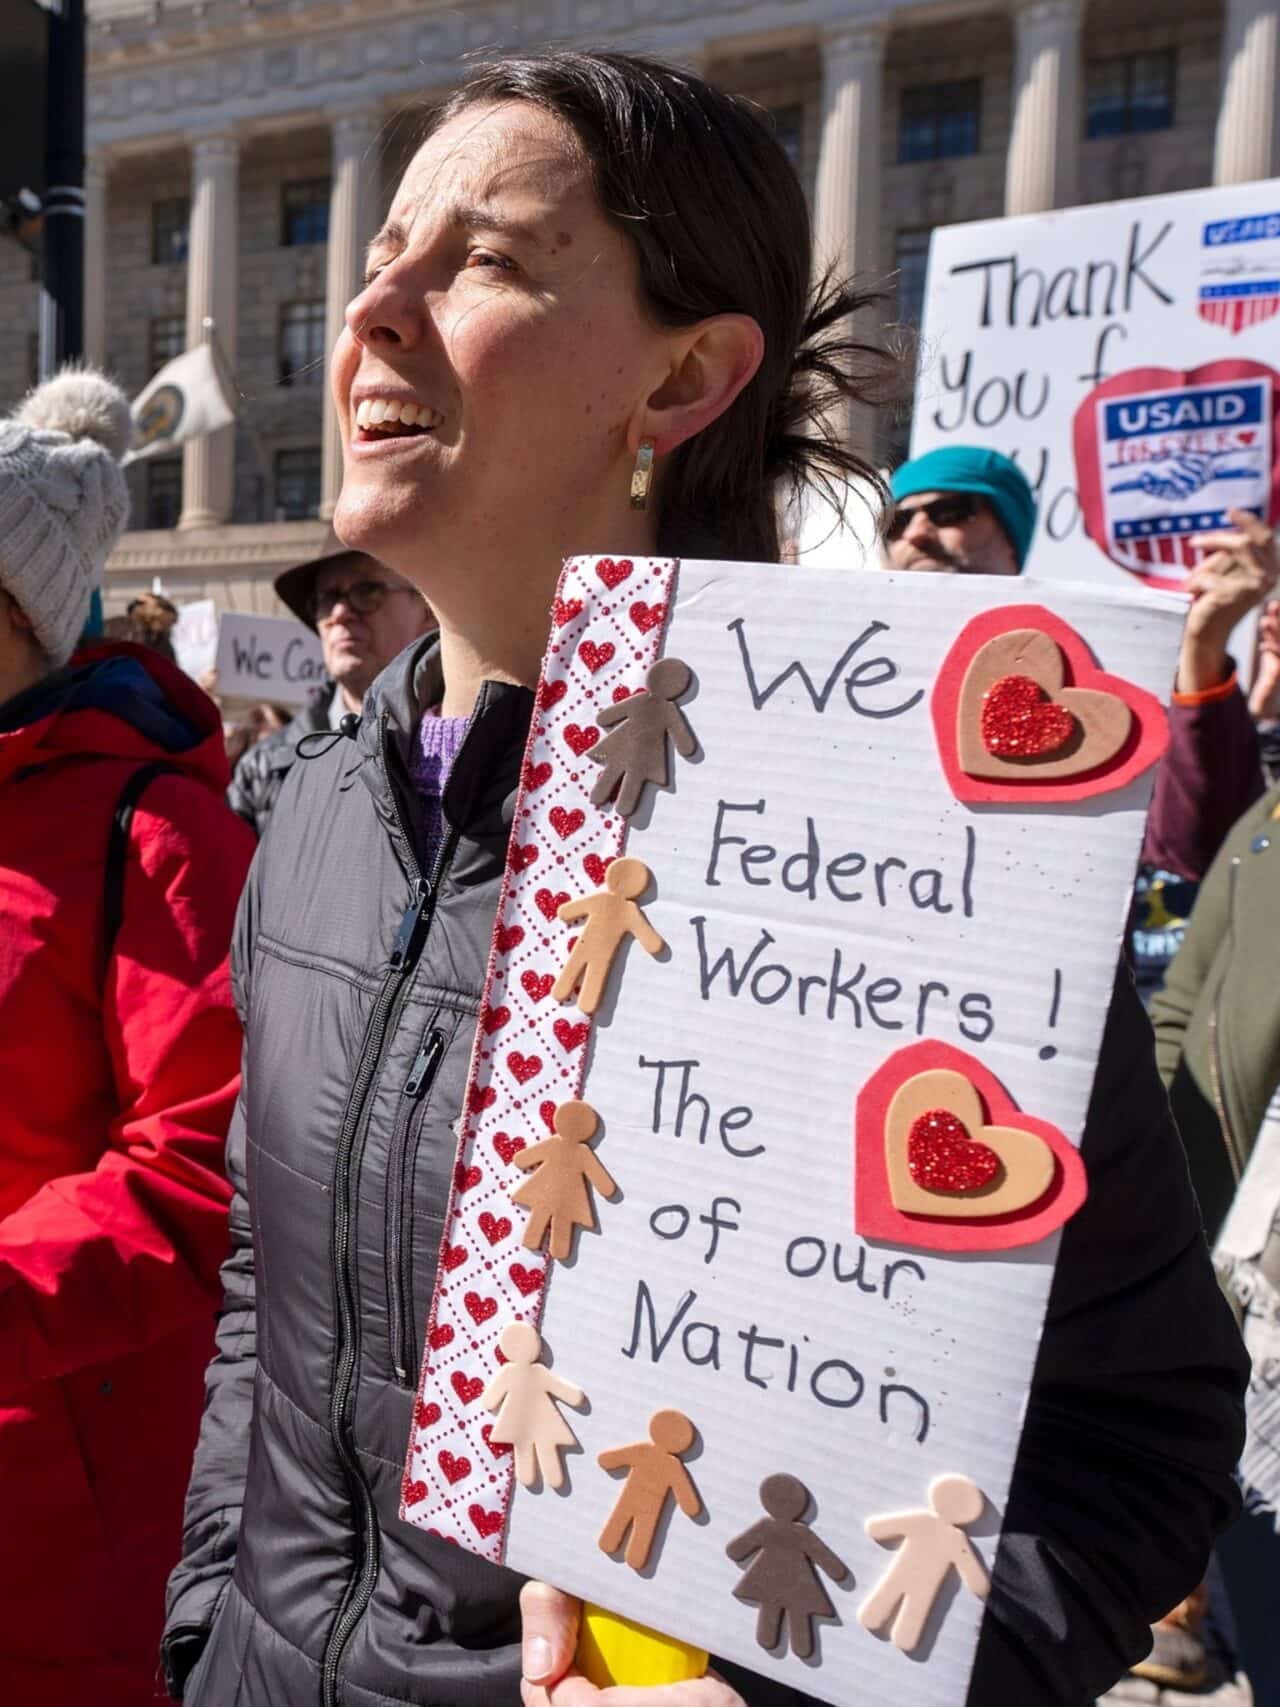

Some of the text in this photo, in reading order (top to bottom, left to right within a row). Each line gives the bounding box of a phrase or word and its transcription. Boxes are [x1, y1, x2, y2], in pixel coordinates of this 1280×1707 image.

[1117, 393, 1246, 433] USAID
[231, 635, 273, 680] We
[727, 617, 925, 720] We
[705, 798, 976, 917] Federal
[638, 1054, 766, 1158] The
[648, 1196, 926, 1300] of our
[620, 1279, 932, 1442] Nation
